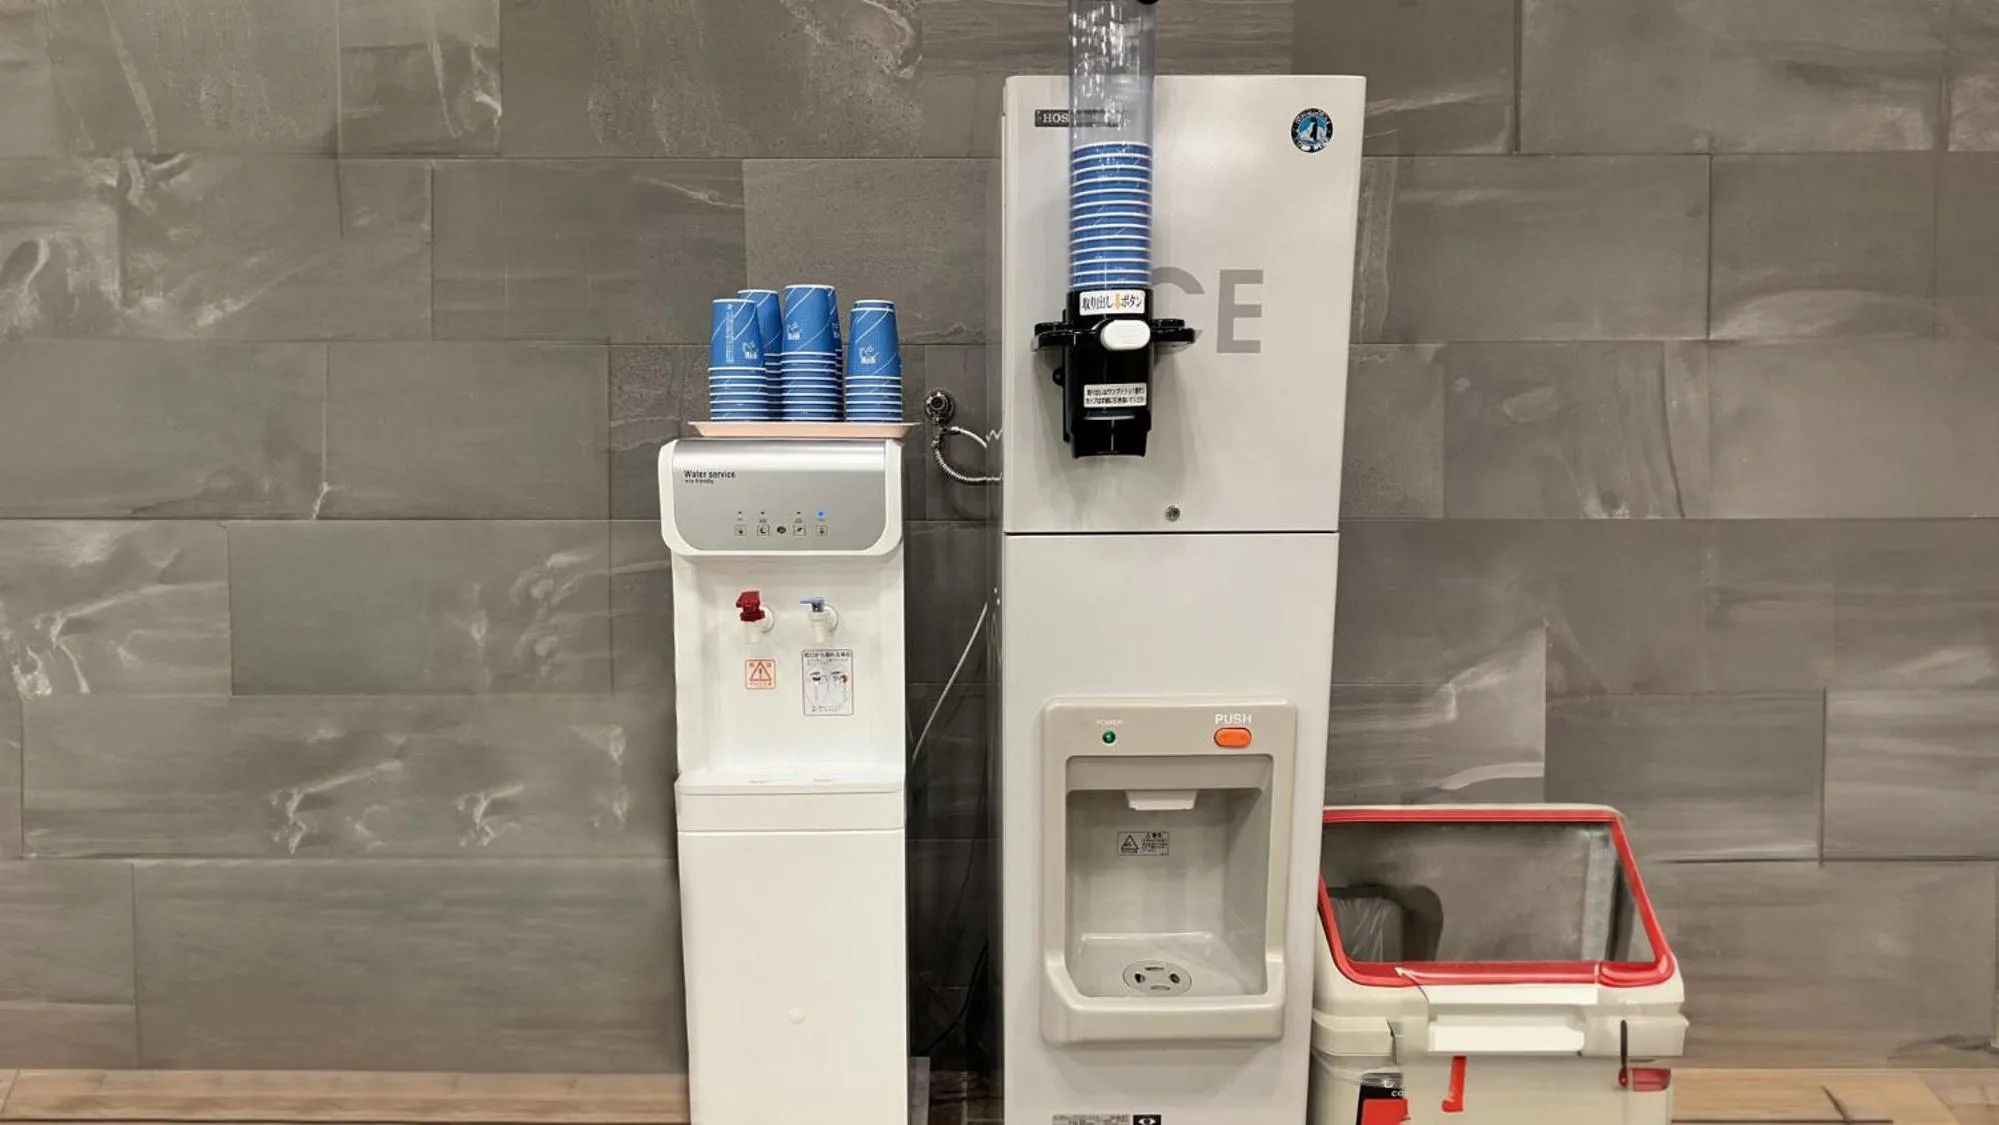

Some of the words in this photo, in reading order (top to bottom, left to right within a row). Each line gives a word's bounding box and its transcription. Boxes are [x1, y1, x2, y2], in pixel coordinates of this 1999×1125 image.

[683, 470, 707, 478] Water
[708, 470, 736, 478] service
[1214, 713, 1253, 725] PUSH
